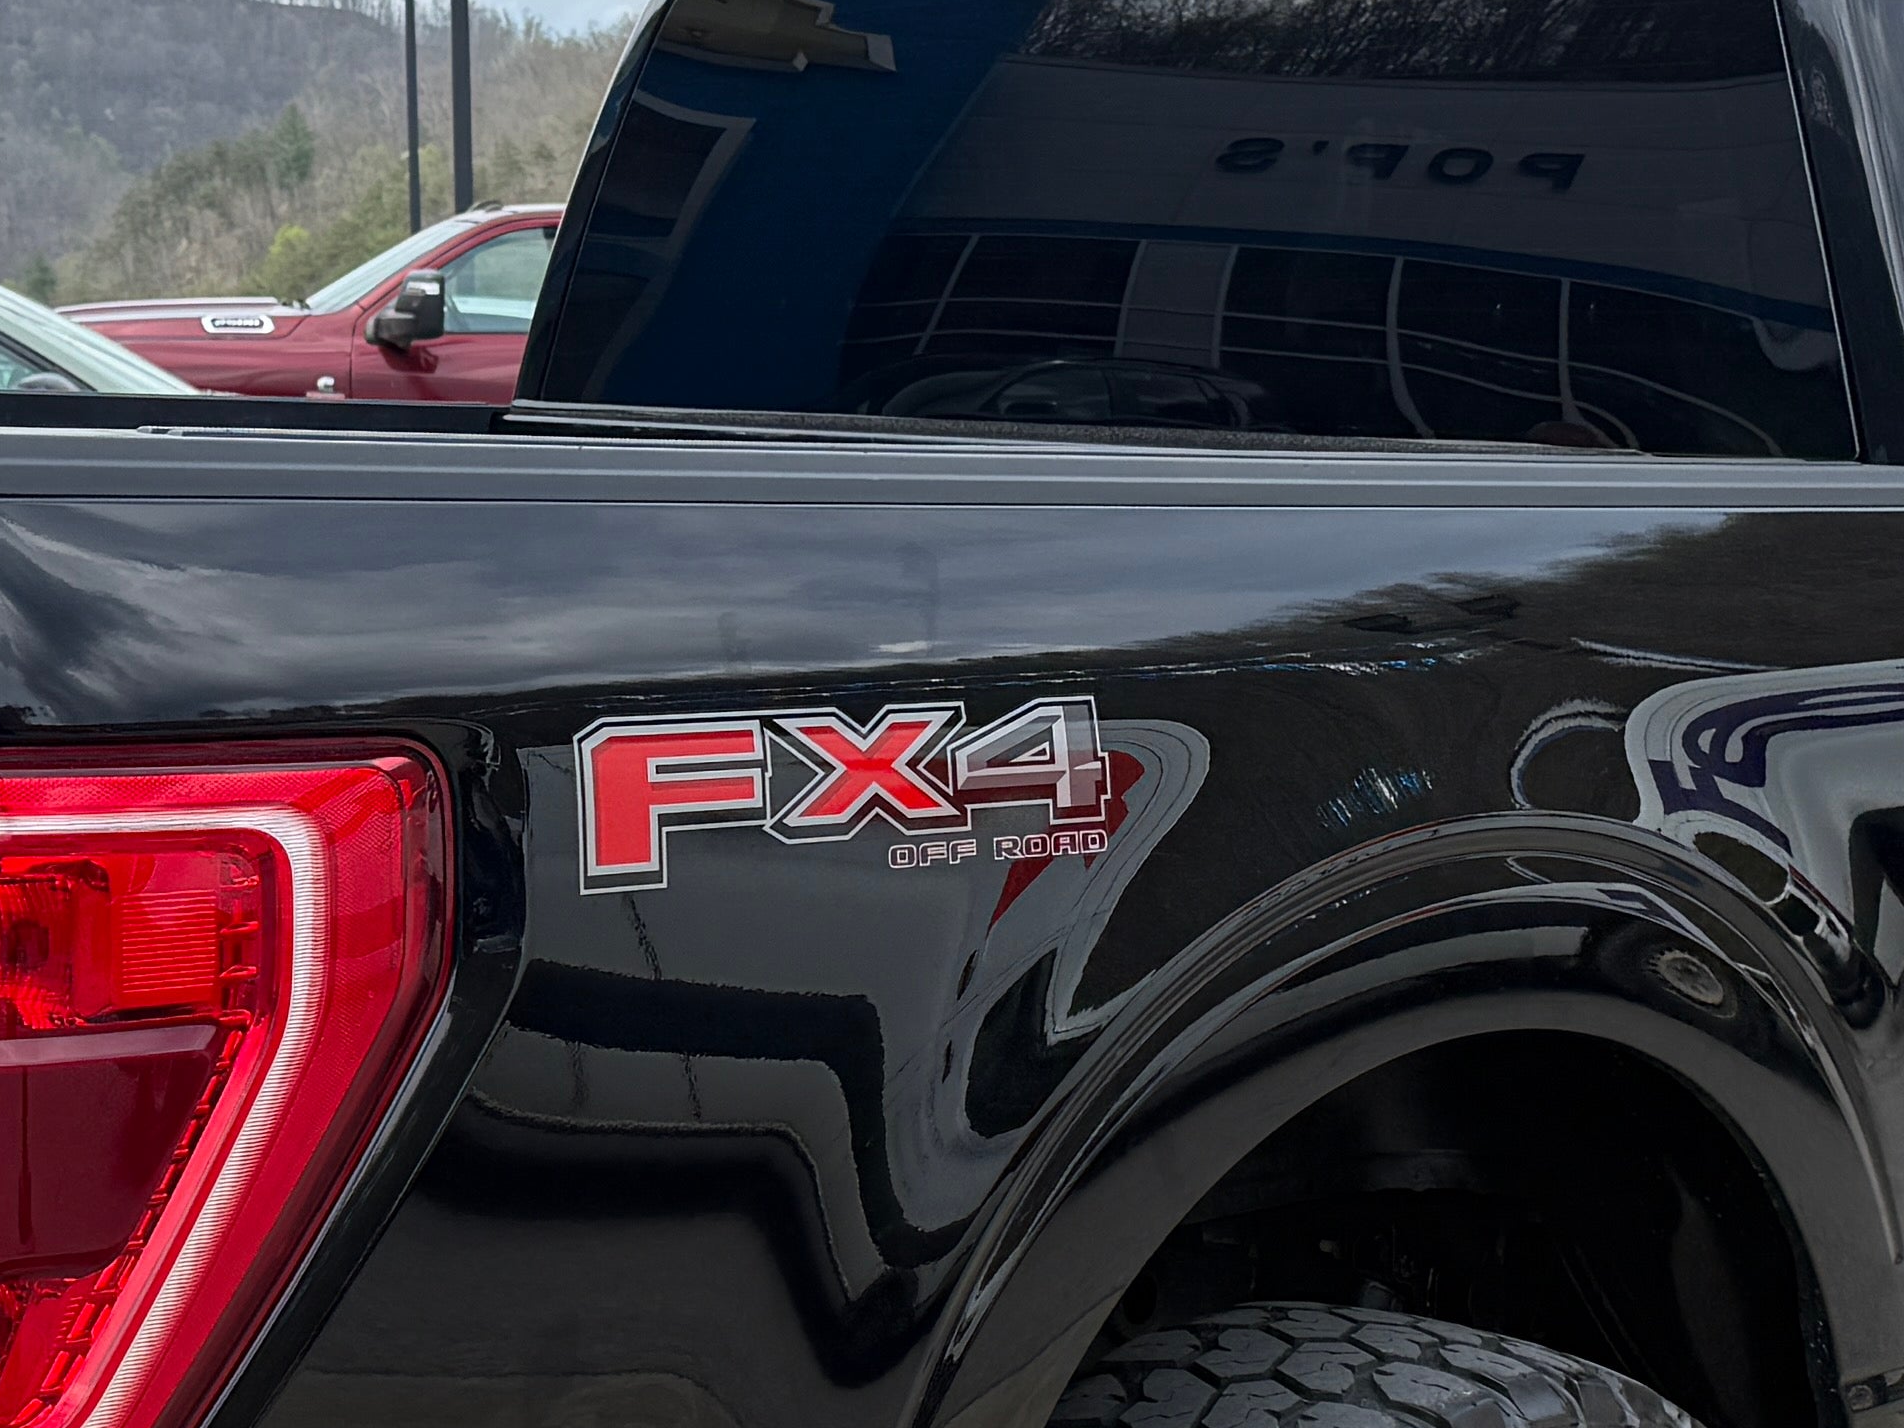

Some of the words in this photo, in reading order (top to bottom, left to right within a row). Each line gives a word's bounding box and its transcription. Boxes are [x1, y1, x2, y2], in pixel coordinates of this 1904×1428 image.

[572, 695, 1112, 896] FX4
[888, 838, 977, 869] OFF
[994, 829, 1108, 861] ROAD
